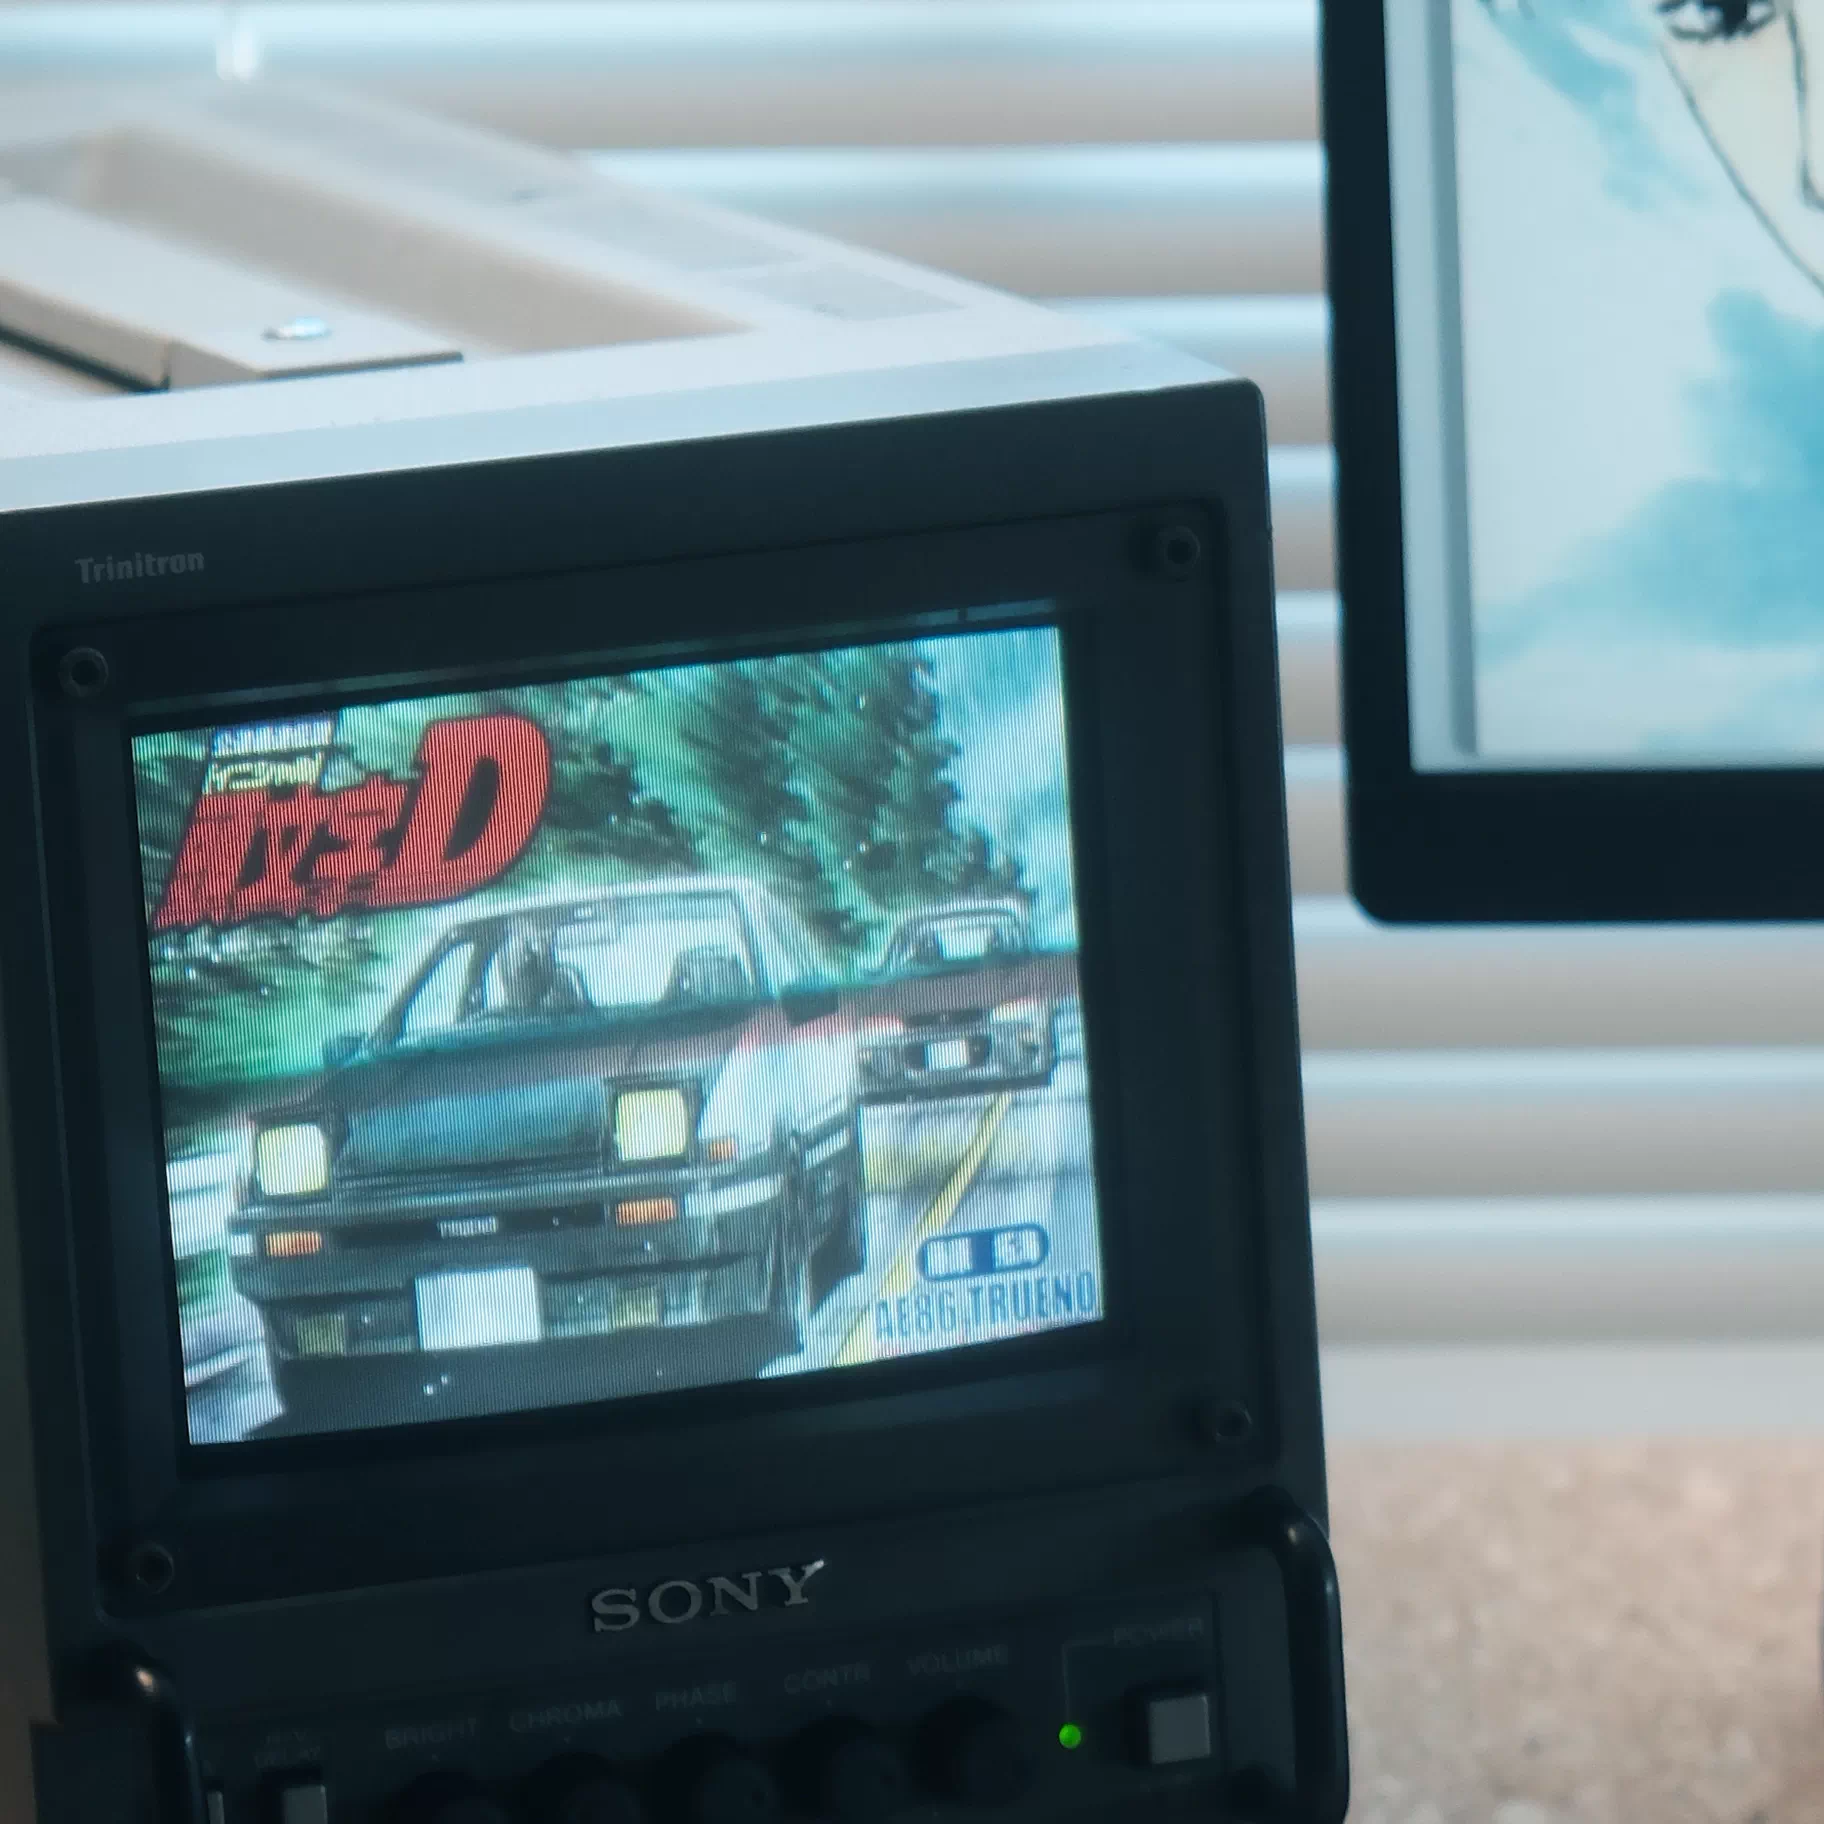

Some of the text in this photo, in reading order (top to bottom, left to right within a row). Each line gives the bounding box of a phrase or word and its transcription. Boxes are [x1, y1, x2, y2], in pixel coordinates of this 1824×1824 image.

[76, 550, 205, 584] Trinitron
[590, 1558, 825, 1633] SONY
[906, 1643, 1010, 1677] VOLUME
[653, 1681, 738, 1712] PHASE
[508, 1698, 623, 1734] CHROMA
[384, 1717, 479, 1751] BRIGHT
